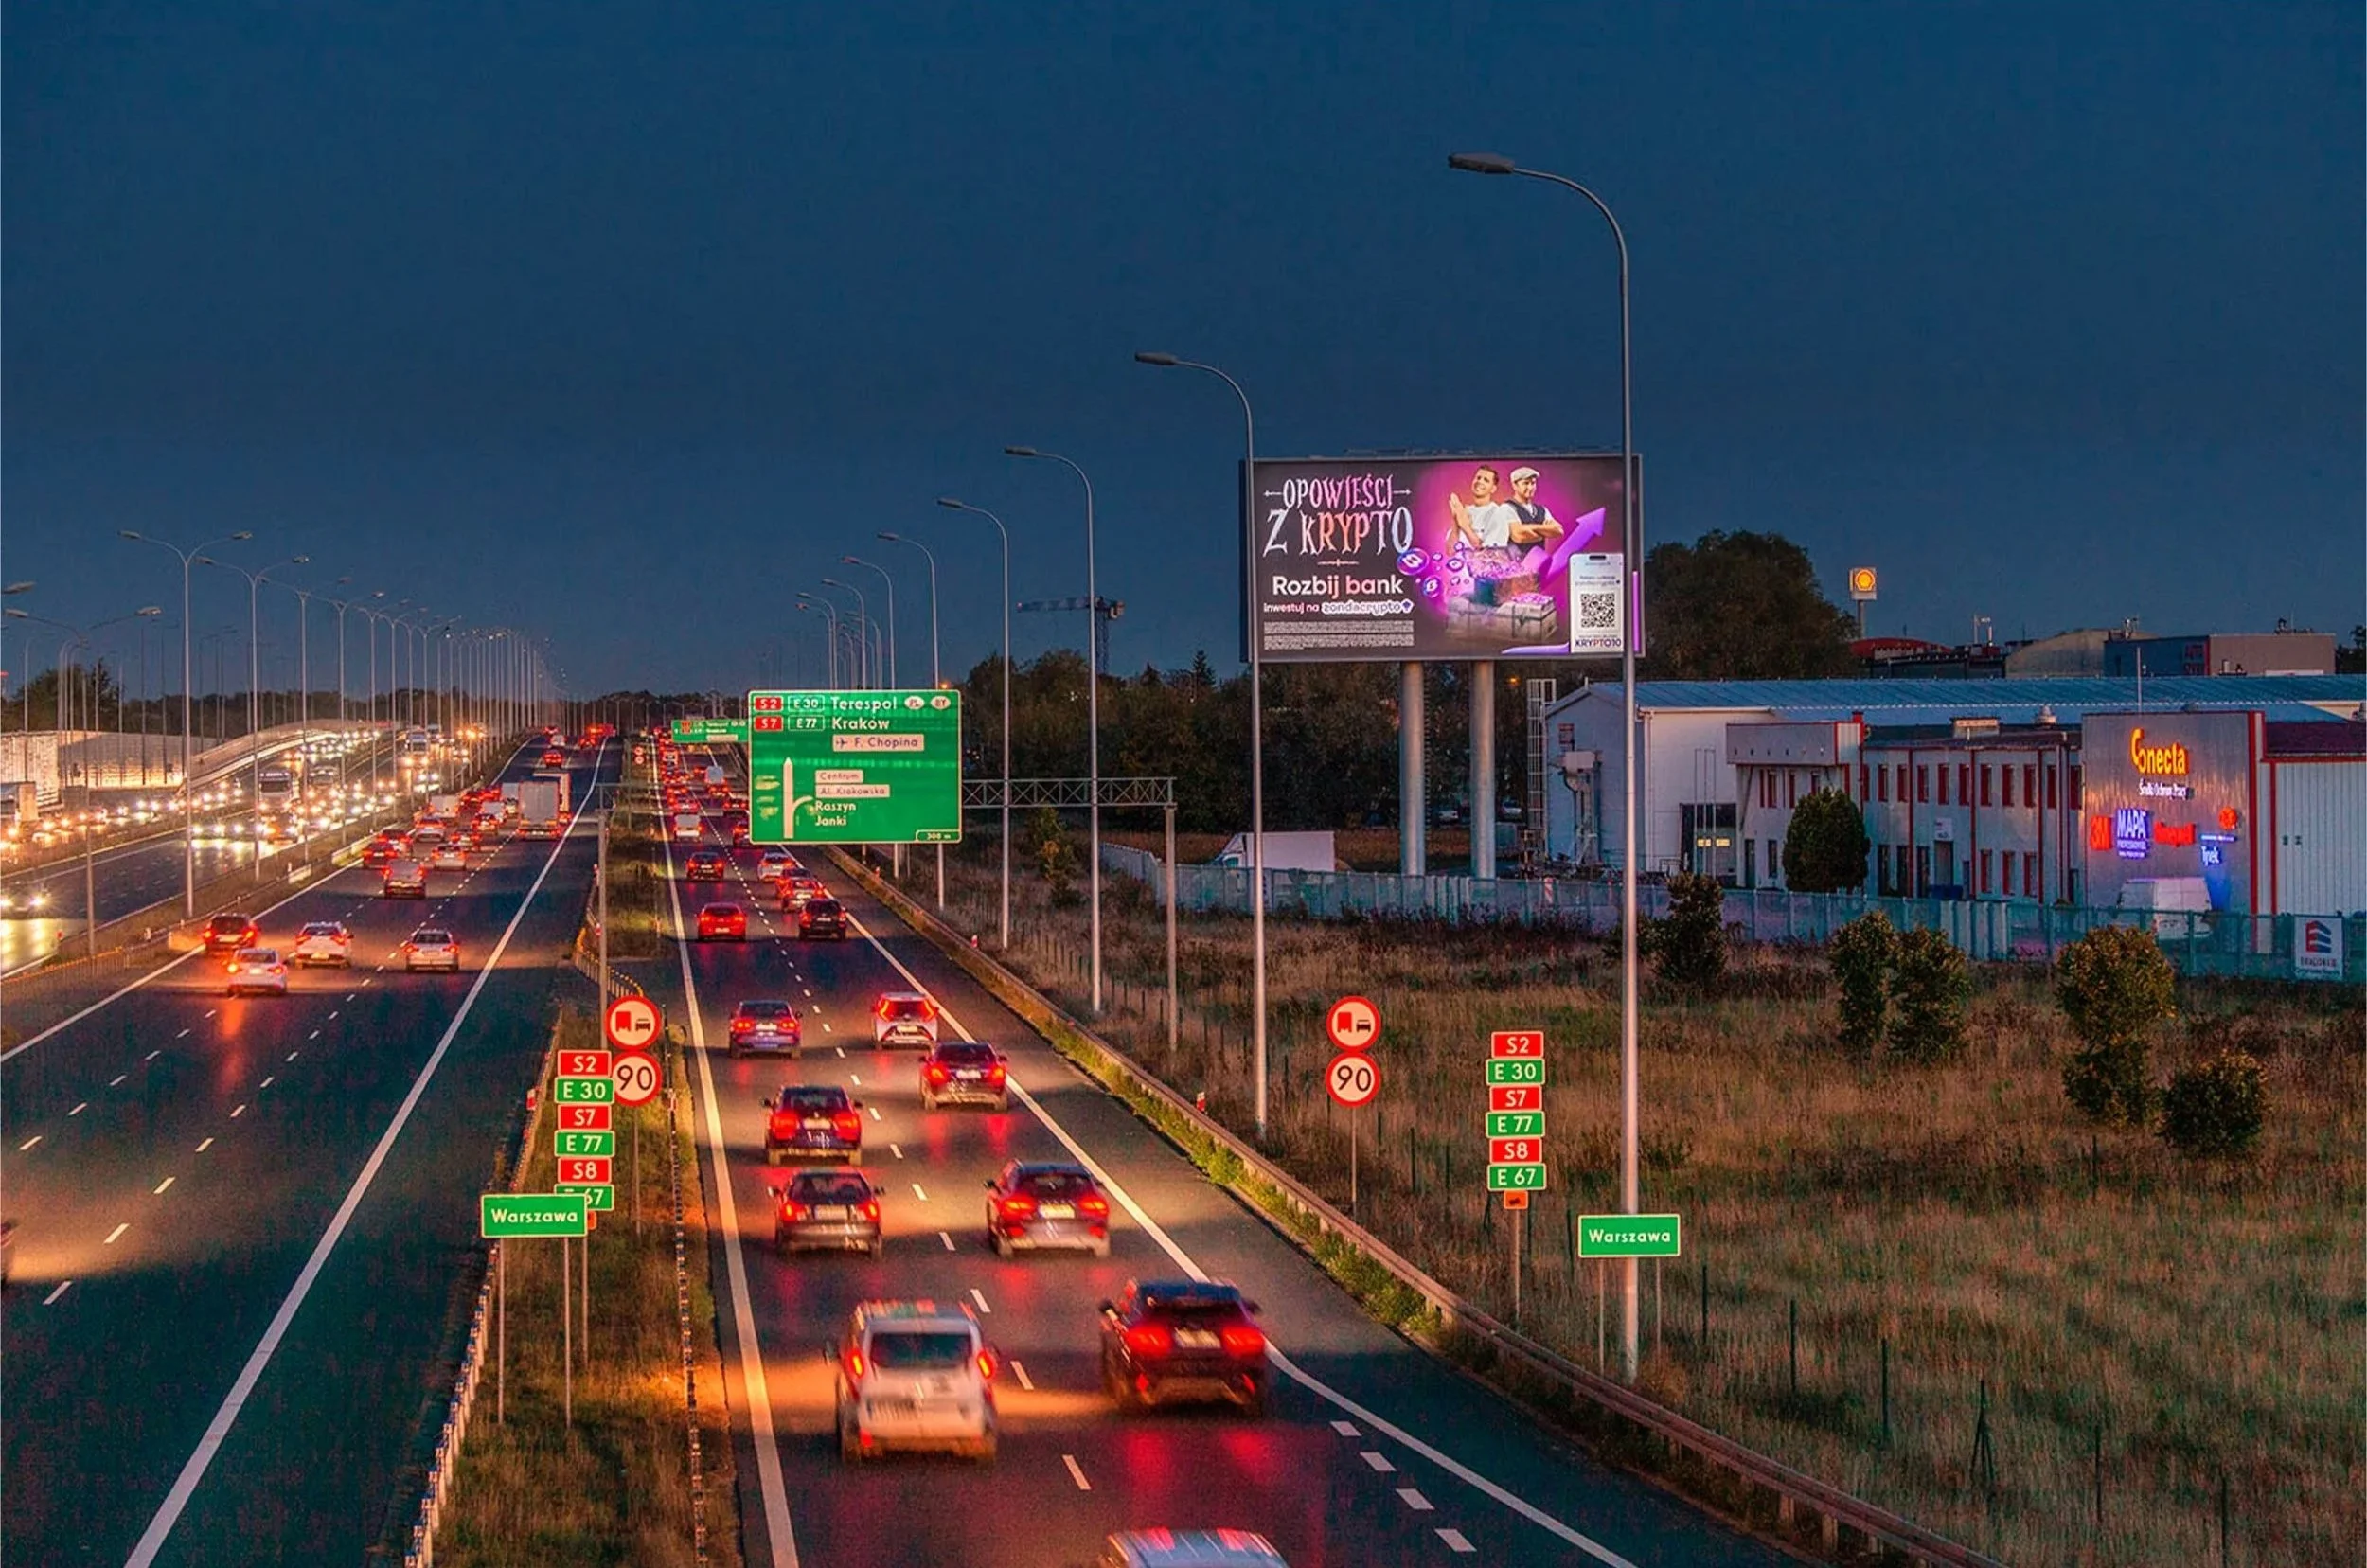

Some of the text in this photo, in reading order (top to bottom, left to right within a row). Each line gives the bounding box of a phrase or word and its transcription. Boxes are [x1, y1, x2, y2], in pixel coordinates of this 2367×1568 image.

[1283, 474, 1393, 509] OPOWIEŚCI
[1263, 506, 1413, 558] Z KRYPTO
[1272, 574, 1403, 599] Rozbij bank
[1306, 604, 1320, 613] na
[1322, 600, 1402, 616] zondacrypto
[1575, 638, 1622, 648] KRYPTO10
[760, 698, 777, 710] S2
[793, 698, 800, 709] E
[803, 698, 819, 709] 30
[830, 696, 897, 714] Terespol
[761, 716, 890, 730] S7 E 77 Kraków
[867, 737, 918, 749] Chopina
[2131, 728, 2187, 775] Conecta
[819, 772, 859, 780] Centrum
[835, 786, 885, 795] Krakowska
[815, 800, 857, 813] Raszyn
[815, 815, 847, 827] Janki
[2116, 809, 2146, 839] MAPA
[1505, 1036, 1530, 1054] S2
[573, 1055, 597, 1073] S2
[1494, 1062, 1537, 1080] E 30
[616, 1064, 653, 1091] 90
[1336, 1064, 1372, 1092] 90
[562, 1081, 606, 1099] E 30
[1504, 1089, 1527, 1108] S7
[573, 1108, 596, 1127] S7
[1497, 1114, 1533, 1133] E 77
[566, 1134, 603, 1152] E 77
[1504, 1141, 1529, 1160] S8
[572, 1161, 598, 1180] S8
[1497, 1167, 1536, 1186] E 67
[490, 1207, 578, 1224] Warszawa
[1588, 1228, 1671, 1243] Warszawa
